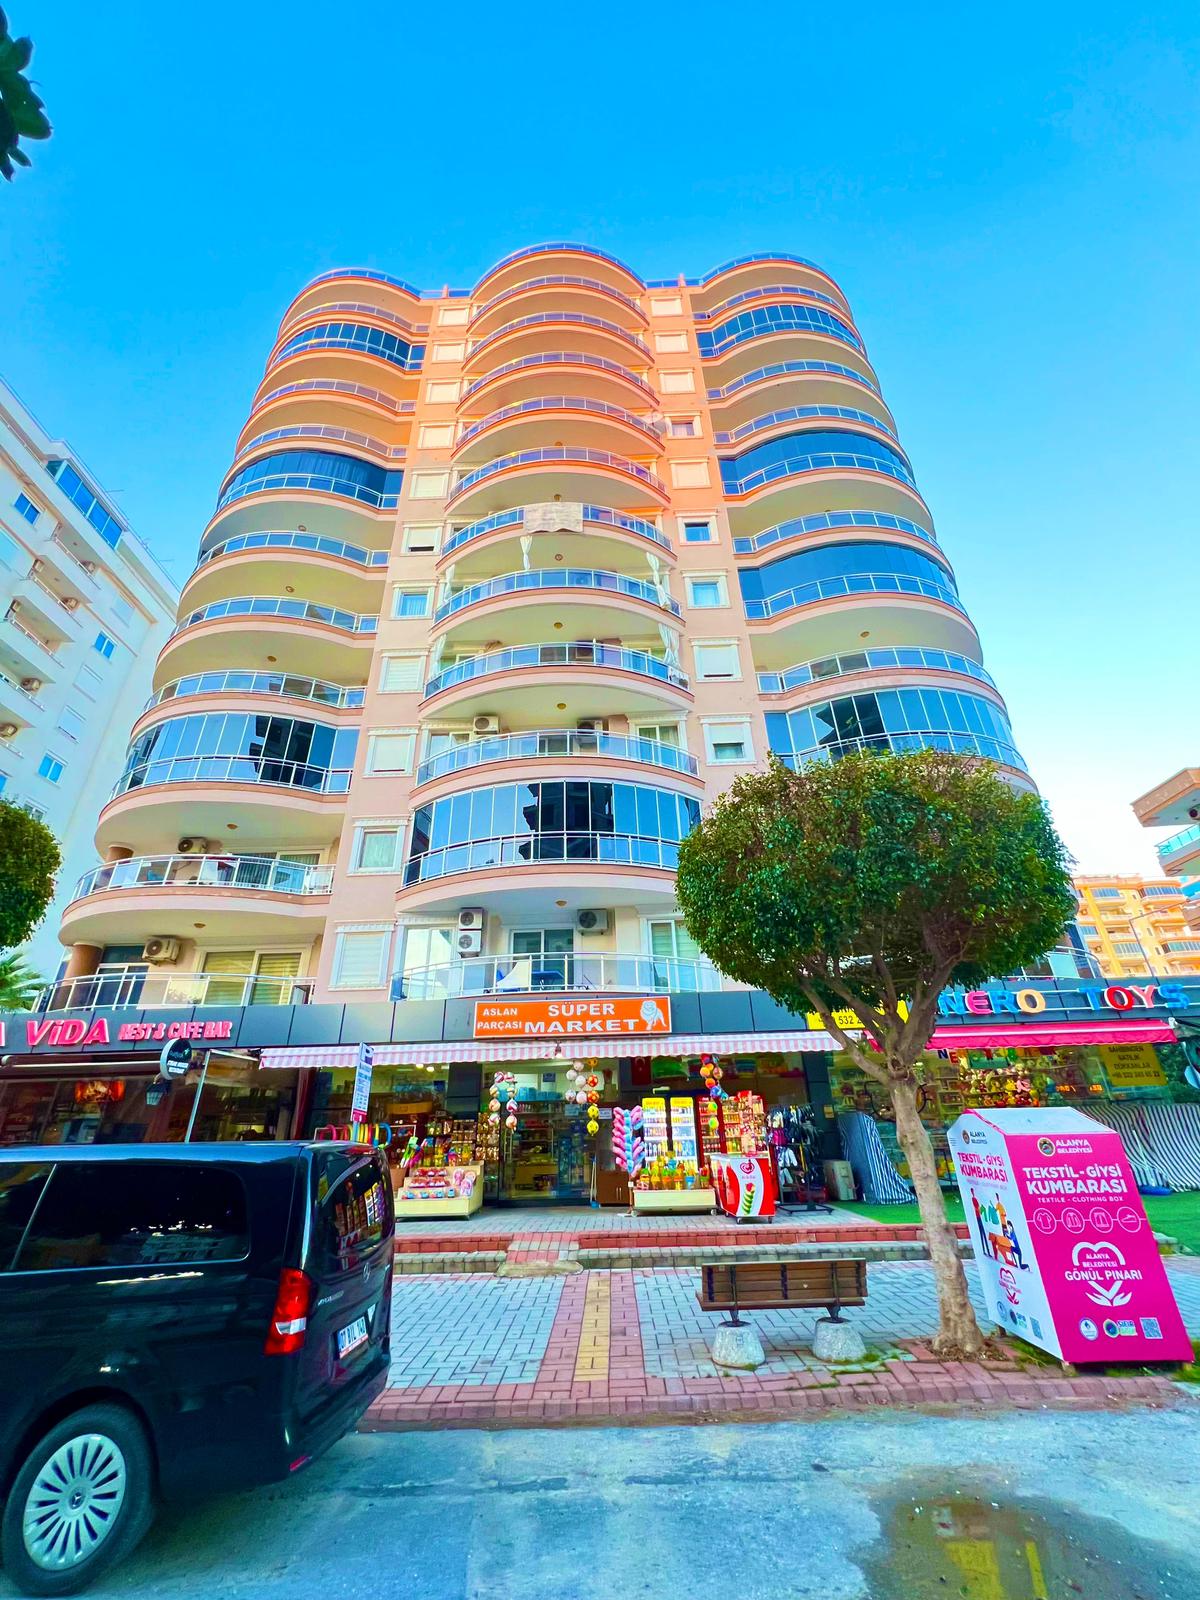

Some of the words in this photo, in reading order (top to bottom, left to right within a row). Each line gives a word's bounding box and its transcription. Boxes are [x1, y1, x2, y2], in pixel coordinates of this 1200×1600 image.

[938, 988, 1046, 1017] NERO
[1079, 985, 1190, 1011] TOYS
[483, 1008, 518, 1016] ASLAN
[548, 1001, 615, 1017] SÜPER
[118, 1023, 155, 1040] REST
[203, 1020, 233, 1038] BAR
[477, 1021, 522, 1030] PARÇASI
[524, 1019, 639, 1033] MARKET
[1056, 1139, 1090, 1147] ALANYA
[960, 1164, 1008, 1182] KUMBARASI
[1022, 1164, 1079, 1178] TEKSTİL
[1086, 1163, 1122, 1177] GİYSİ
[1026, 1179, 1128, 1194] KUMBARASI
[1065, 1268, 1104, 1280] GÖNÜL
[1105, 1270, 1143, 1280] PINARI
